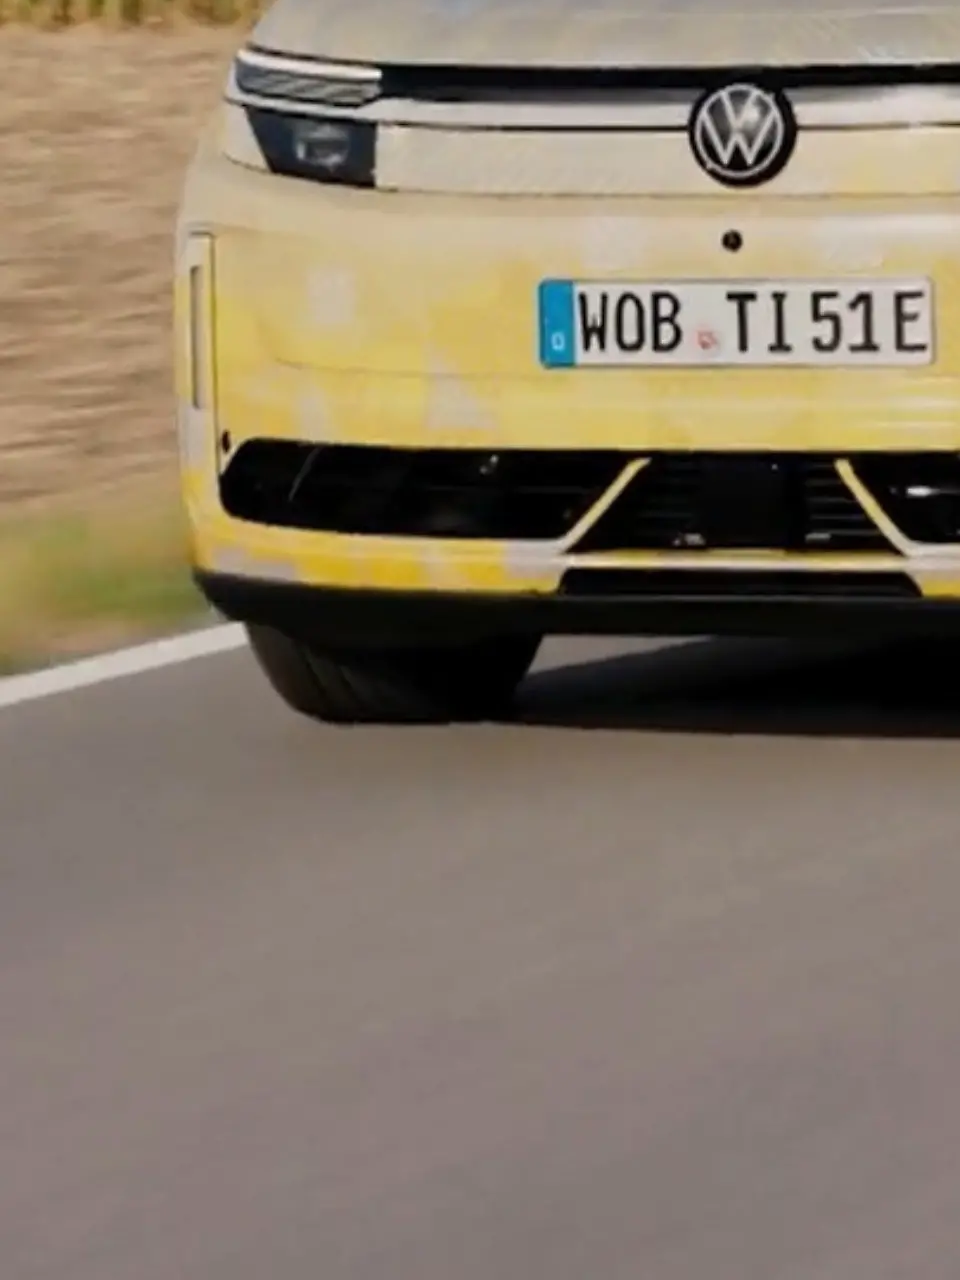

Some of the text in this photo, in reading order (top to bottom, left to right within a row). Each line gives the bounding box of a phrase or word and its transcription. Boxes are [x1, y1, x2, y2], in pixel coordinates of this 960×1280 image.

[578, 290, 929, 354] WOB TI 51E
